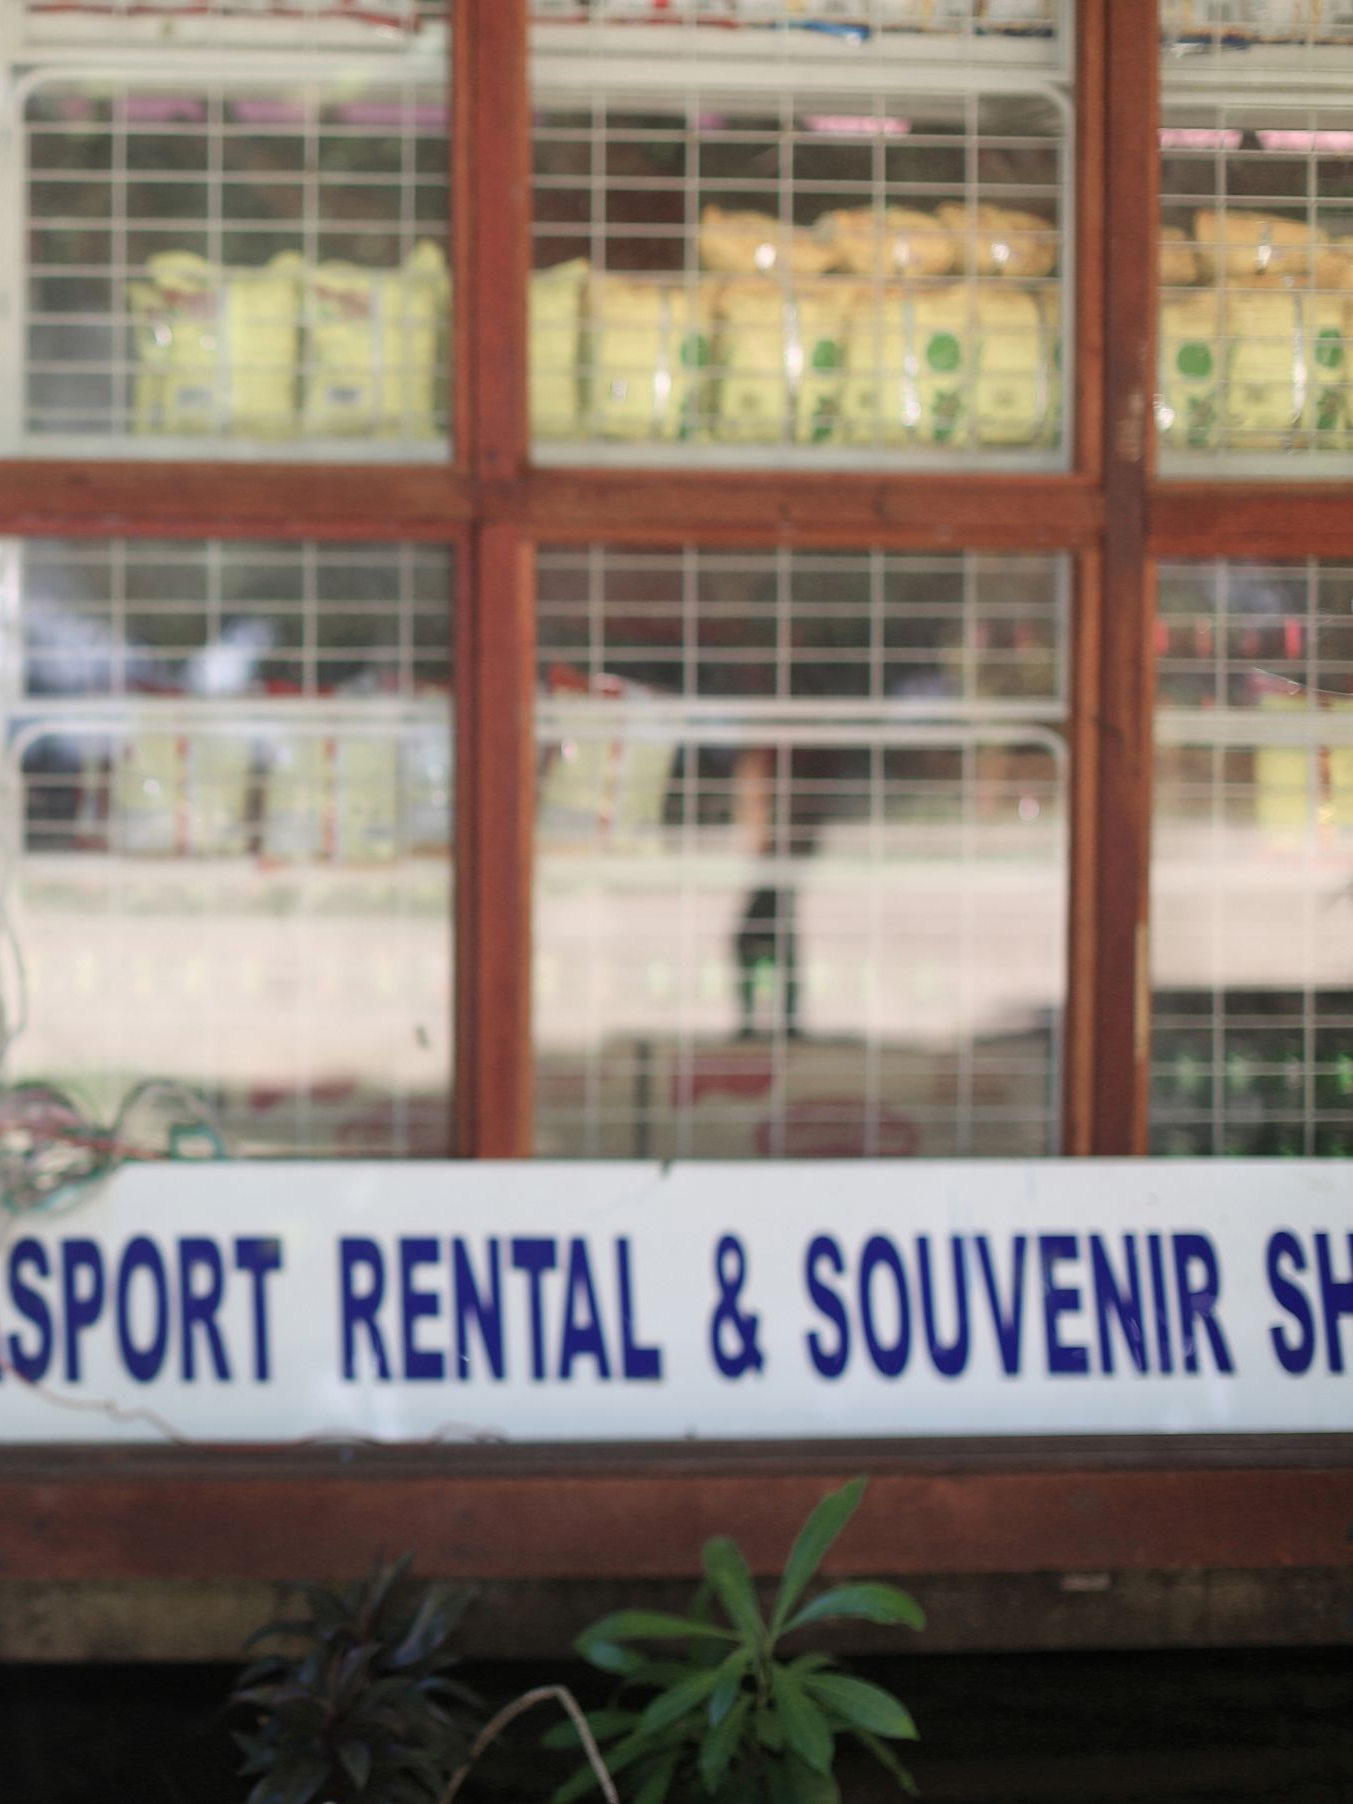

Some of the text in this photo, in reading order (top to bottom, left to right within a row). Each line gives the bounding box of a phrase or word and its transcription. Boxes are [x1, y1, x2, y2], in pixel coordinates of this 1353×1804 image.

[338, 1235, 664, 1382] RENTAL
[709, 1233, 765, 1380] &
[803, 1232, 1235, 1380] SOUVENIR
